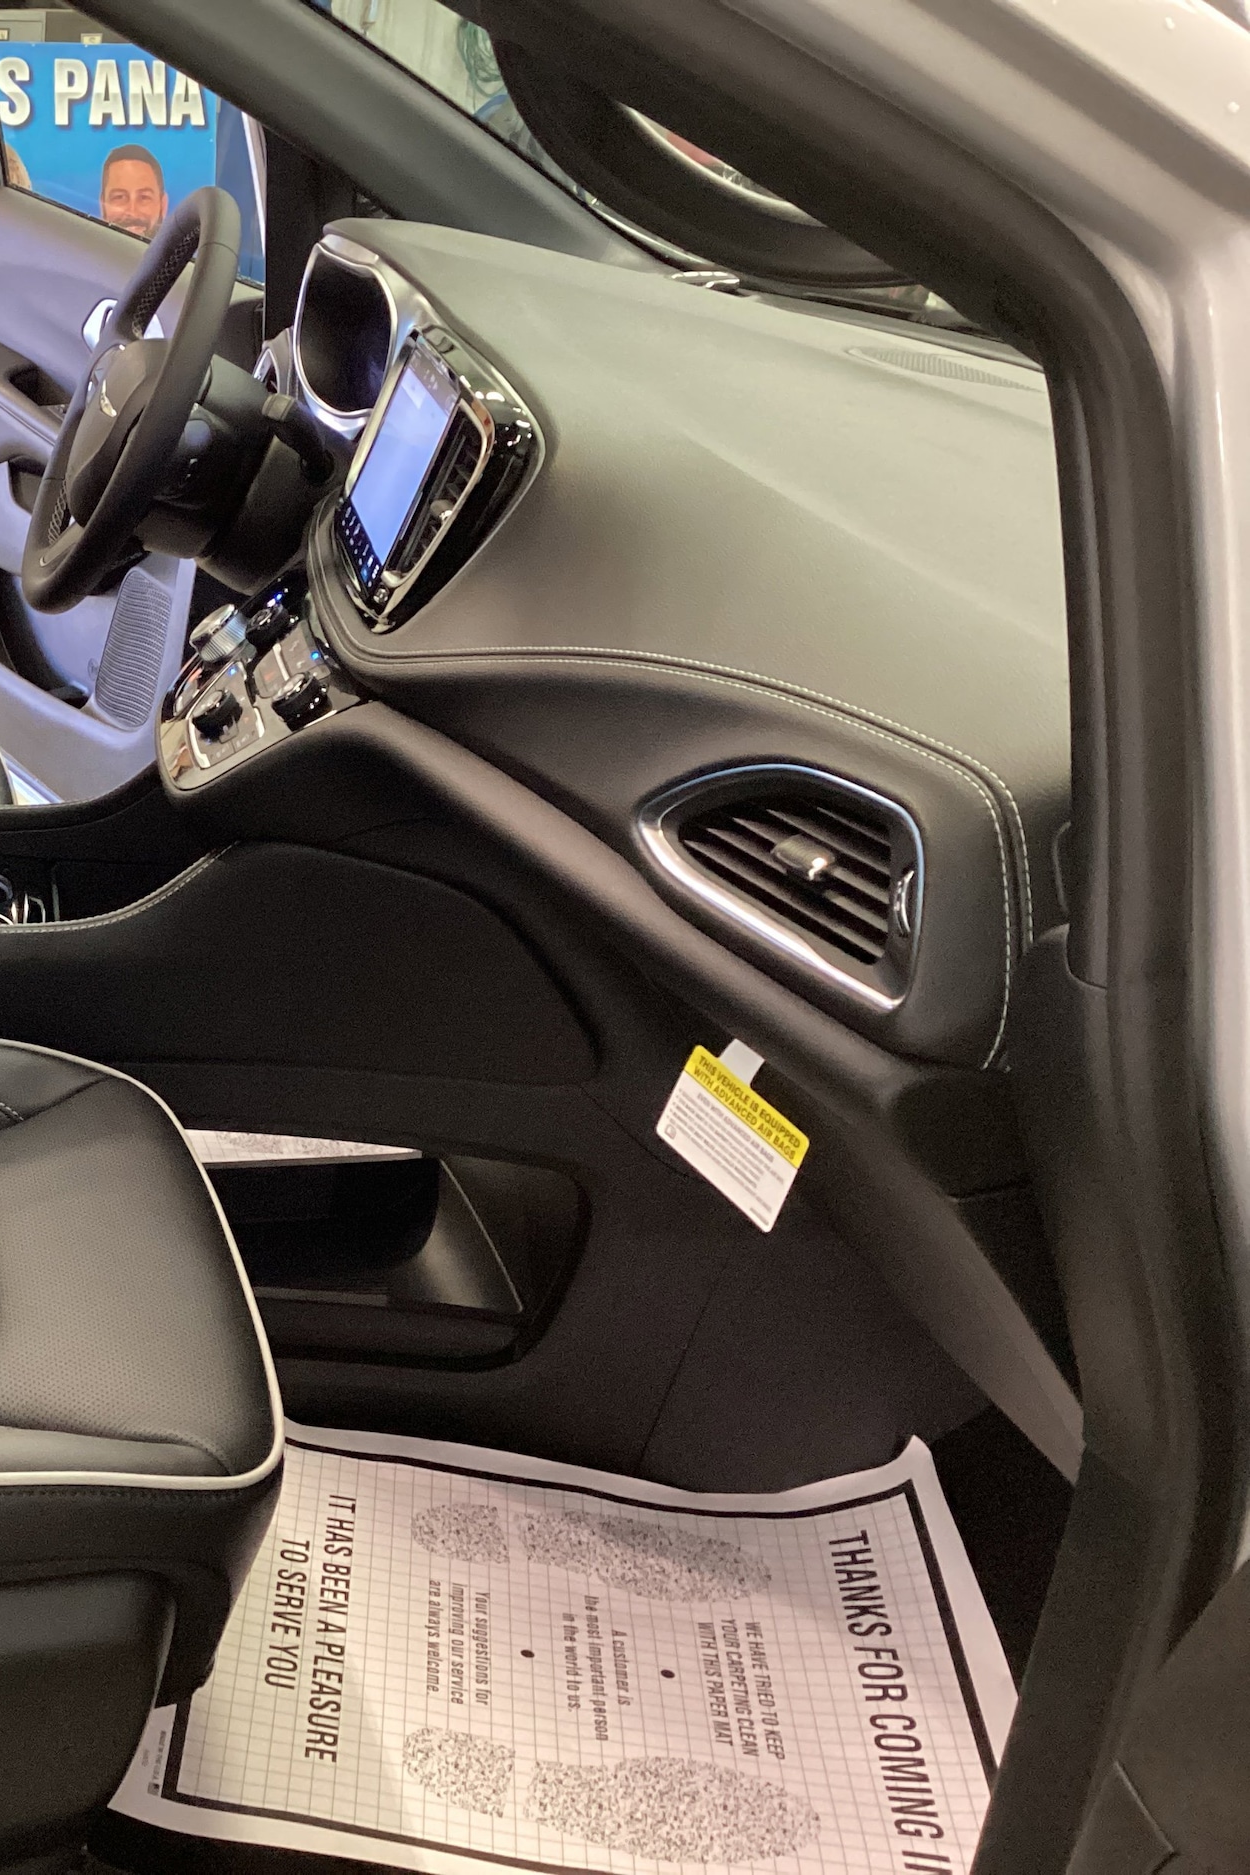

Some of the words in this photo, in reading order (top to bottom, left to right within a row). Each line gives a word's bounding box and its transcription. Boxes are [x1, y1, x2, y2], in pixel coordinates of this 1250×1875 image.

[54, 58, 205, 126] PANA
[692, 1065, 714, 1088] WITH
[712, 1084, 758, 1127] ADVANCED
[757, 1121, 773, 1140] AIR
[772, 1134, 796, 1160] BAGS
[698, 1055, 717, 1076] THIS
[717, 1071, 752, 1106] VEHICLE
[749, 1099, 759, 1113] IS
[758, 1107, 801, 1149] EQUIPPED
[328, 1494, 356, 1513] IT
[280, 1539, 310, 1563] TO
[323, 1518, 354, 1556] HAS
[318, 1562, 350, 1615] BEEN
[429, 1580, 441, 1597] are
[829, 1530, 892, 1636] THANKS
[271, 1569, 307, 1637] SERVE
[449, 1583, 468, 1636] improving
[475, 1592, 490, 1615] Your
[563, 1613, 578, 1622] in
[584, 1595, 600, 1611] the
[316, 1620, 346, 1634] A
[425, 1601, 443, 1638] always
[564, 1625, 579, 1642] the
[587, 1614, 602, 1639] most
[721, 1619, 740, 1648] YOUR
[745, 1622, 763, 1638] WE
[451, 1640, 464, 1659] our
[472, 1618, 491, 1685] suggestions
[698, 1623, 719, 1650] WITH
[265, 1644, 299, 1690] YOU
[427, 1642, 443, 1696] welcome.
[564, 1646, 582, 1676] world
[586, 1642, 608, 1696] important
[612, 1640, 630, 1692] customer
[702, 1653, 721, 1677] THIS
[749, 1642, 769, 1670] HAVE
[451, 1661, 467, 1704] service
[567, 1680, 582, 1690] to
[726, 1651, 752, 1716] CARPETING
[854, 1647, 908, 1701] FOR
[304, 1641, 344, 1762] PLEASURE
[476, 1688, 491, 1705] for
[568, 1695, 581, 1712] us.
[618, 1696, 634, 1706] is
[706, 1680, 728, 1717] PAPER
[755, 1675, 775, 1707] TRIED
[589, 1700, 609, 1741] person
[714, 1721, 733, 1746] MAT
[761, 1712, 779, 1726] TO
[738, 1718, 759, 1757] CLEAN
[765, 1729, 785, 1760] KEEP
[870, 1714, 944, 1839] COMING
